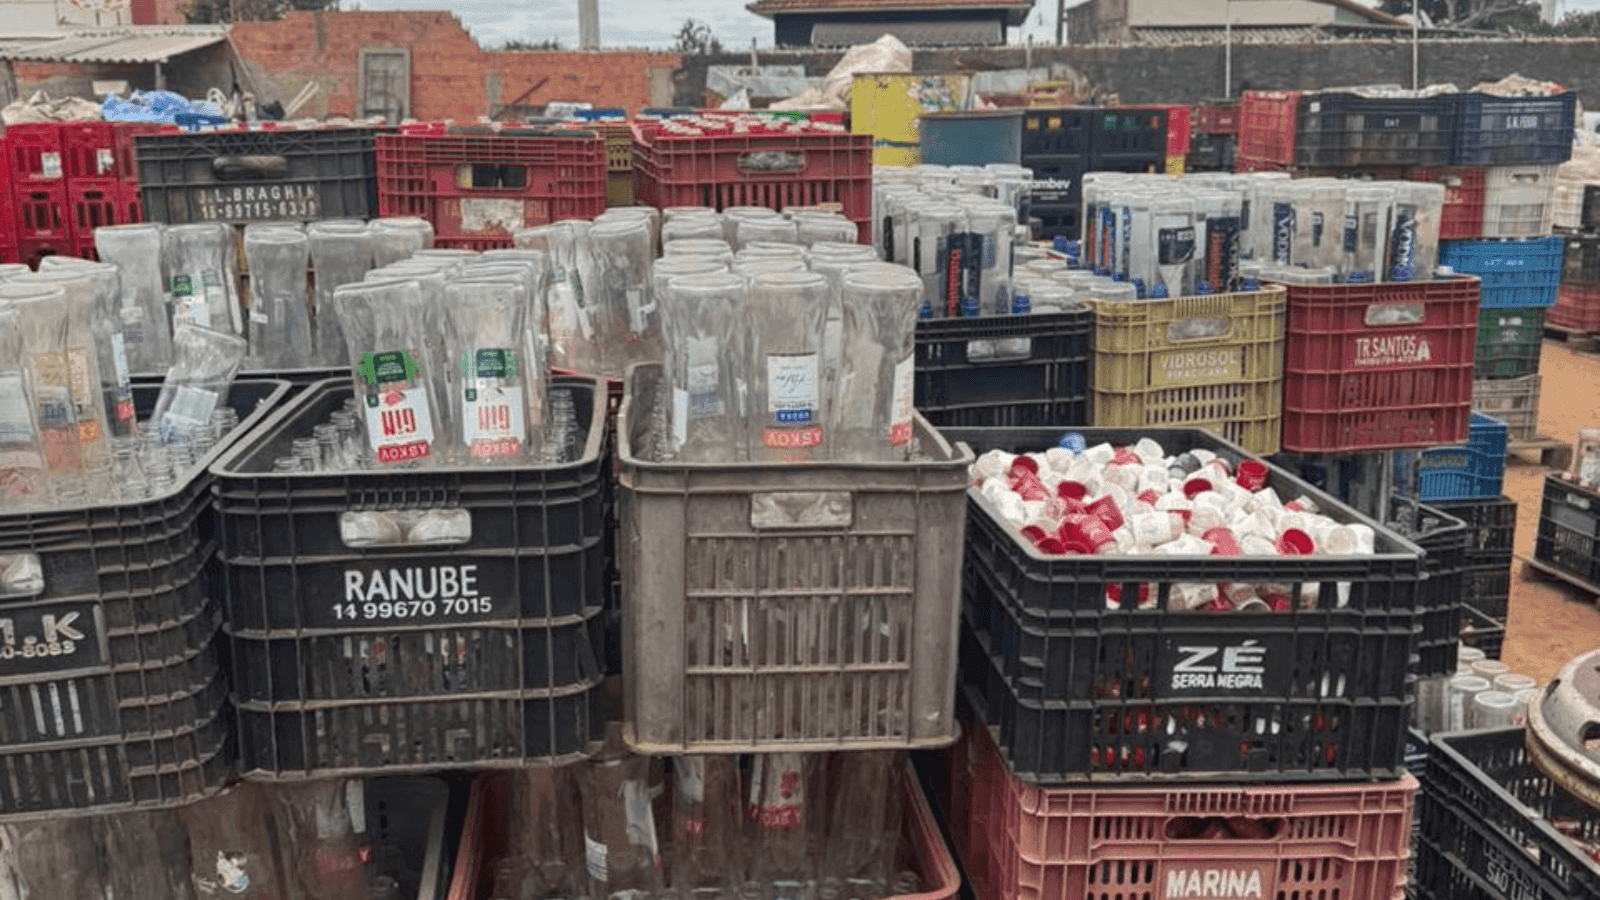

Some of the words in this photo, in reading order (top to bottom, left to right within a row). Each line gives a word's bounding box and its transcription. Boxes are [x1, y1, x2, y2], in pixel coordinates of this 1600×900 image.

[1159, 349, 1238, 370] VIDROSOL
[380, 442, 429, 462] ASKOV
[344, 565, 479, 602] RANUBE
[333, 603, 358, 620] 14
[363, 600, 437, 619] 99670
[442, 597, 493, 615] 7015
[1173, 639, 1267, 674] ZÉ
[1171, 674, 1215, 690] SERRA
[1217, 674, 1263, 690] NEGRA
[1165, 868, 1262, 899] MARINA
